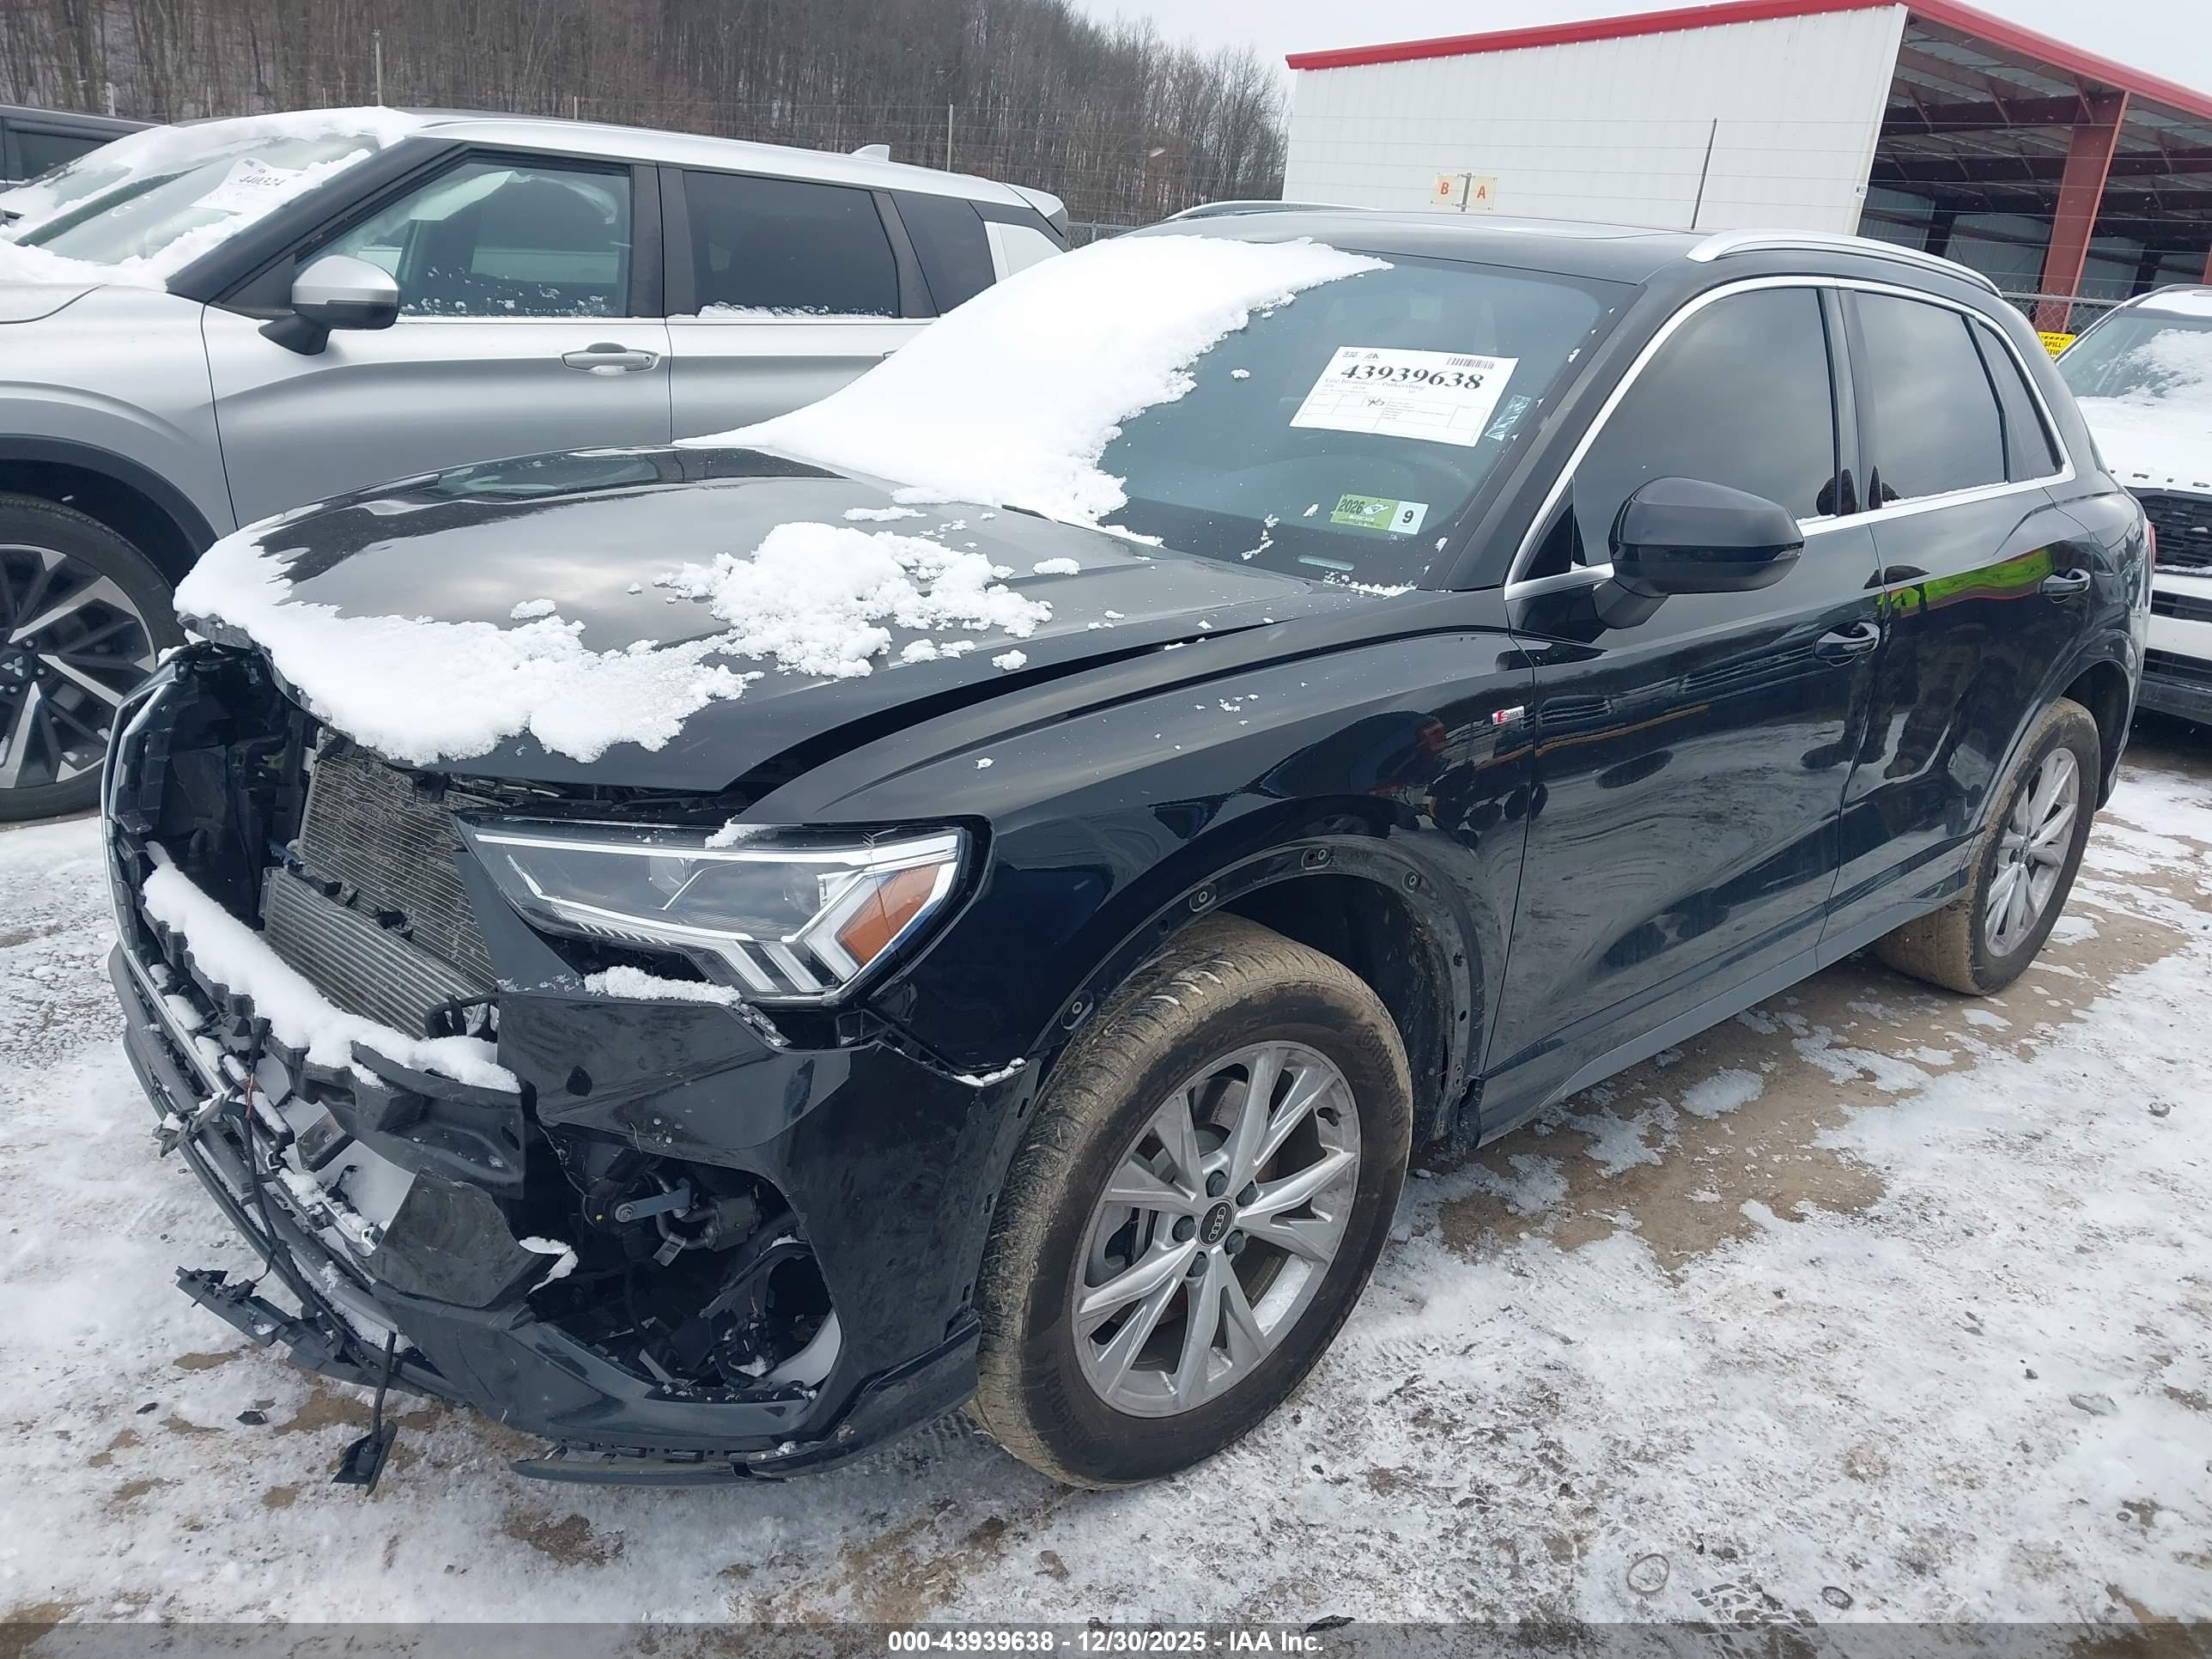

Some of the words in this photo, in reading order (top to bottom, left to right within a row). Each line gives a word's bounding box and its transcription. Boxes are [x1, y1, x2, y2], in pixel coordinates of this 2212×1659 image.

[1440, 181, 1449, 195] B
[1476, 185, 1486, 199] A
[1340, 365, 1484, 390] 43939638
[1338, 498, 1365, 515] 2026
[1402, 509, 1414, 524] 9
